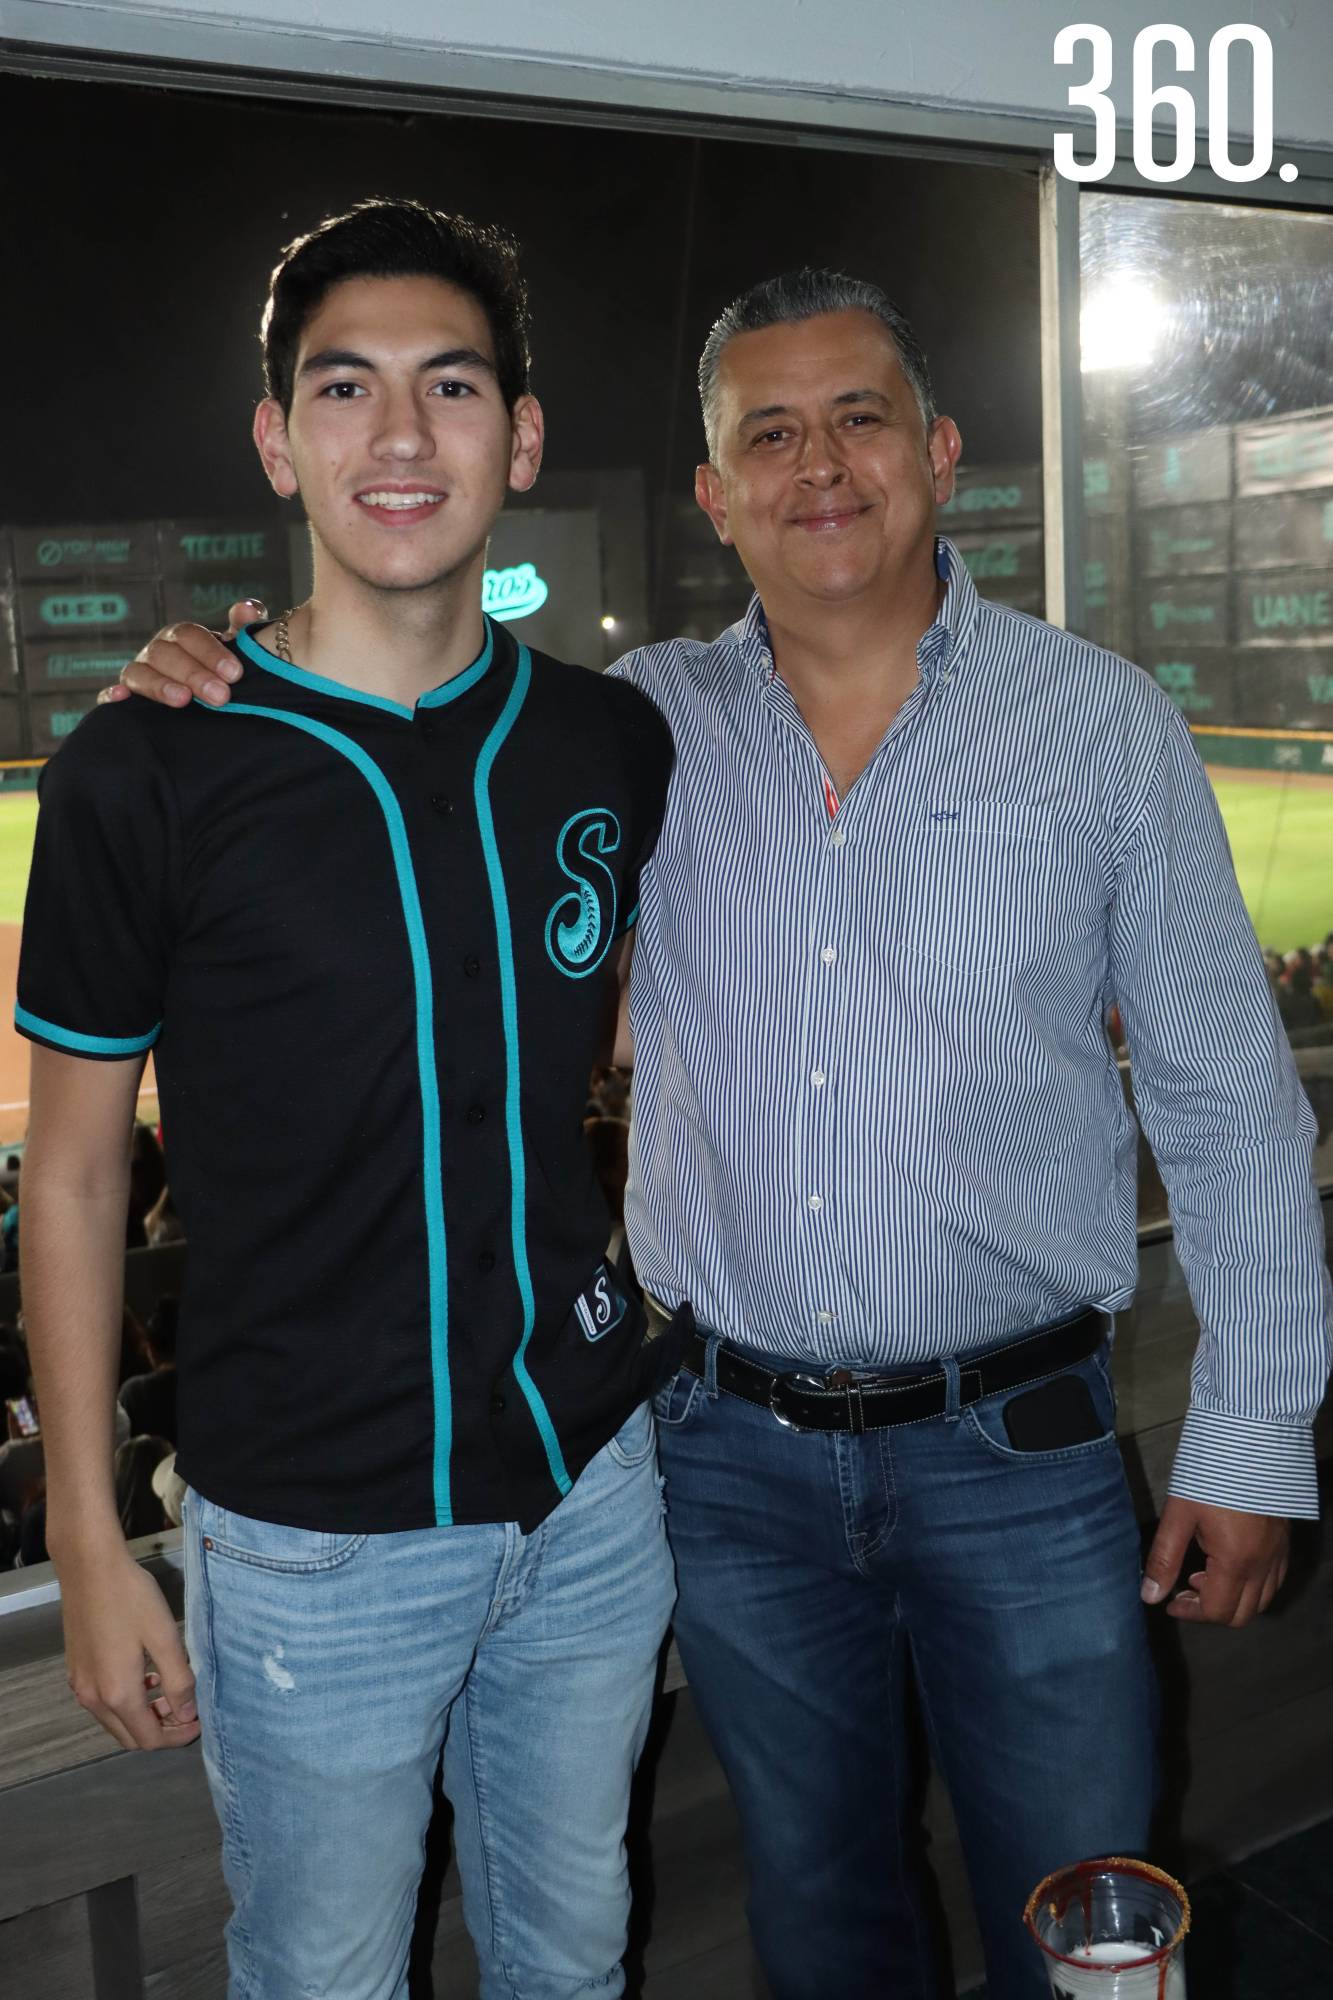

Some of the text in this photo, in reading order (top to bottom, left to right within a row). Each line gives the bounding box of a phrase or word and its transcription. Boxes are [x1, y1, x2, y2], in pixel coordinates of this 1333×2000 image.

[180, 533, 265, 560] TECATE
[1252, 591, 1331, 627] UANE
[545, 808, 620, 979] S
[594, 1276, 612, 1325] S
